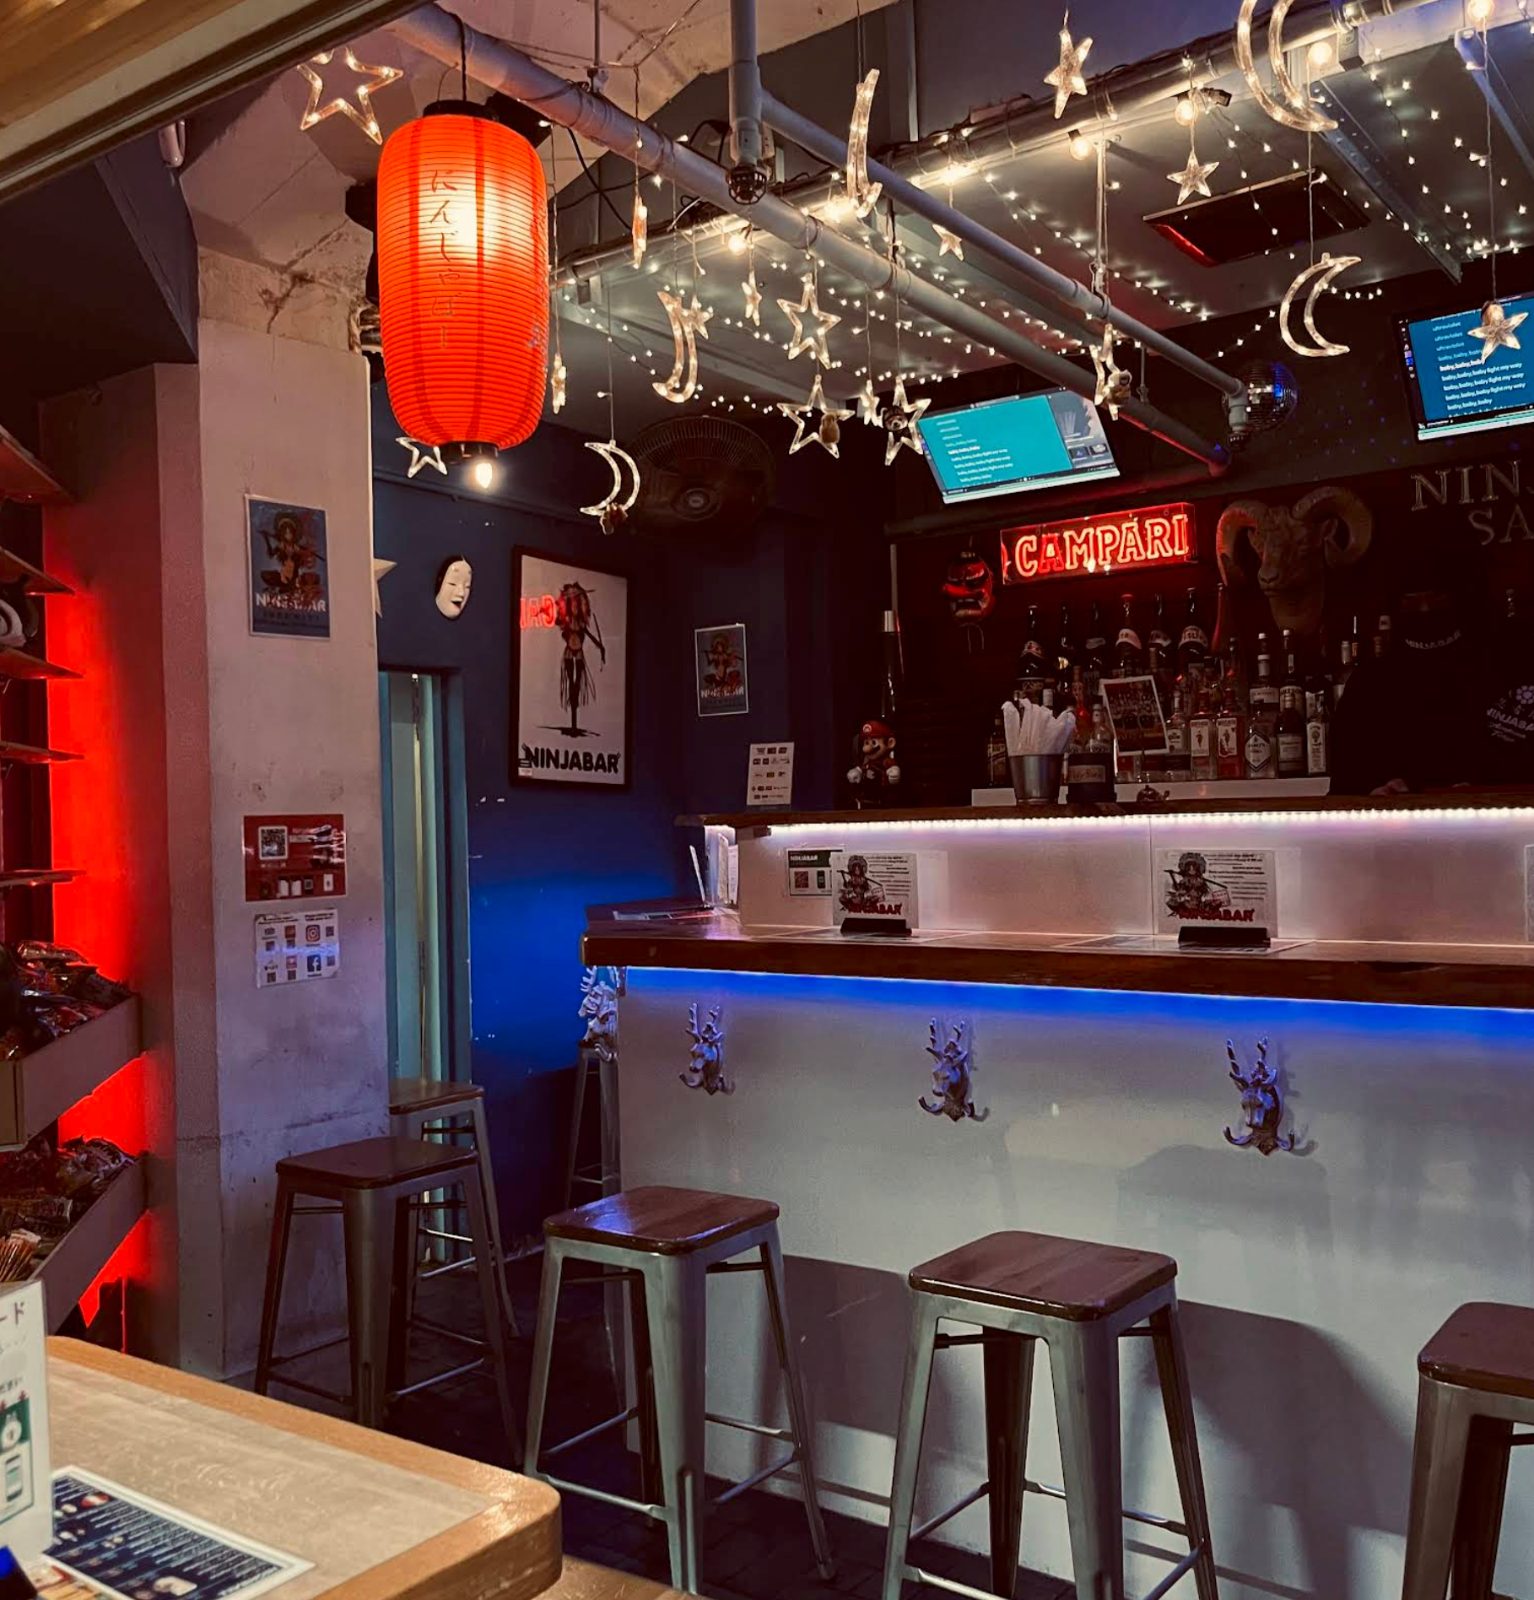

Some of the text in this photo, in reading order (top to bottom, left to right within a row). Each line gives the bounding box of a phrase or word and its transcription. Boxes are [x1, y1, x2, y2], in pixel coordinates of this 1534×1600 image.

[1411, 460, 1534, 511] NIN
[1015, 514, 1189, 577] CAMPARI
[523, 746, 620, 773] NINJABAR
